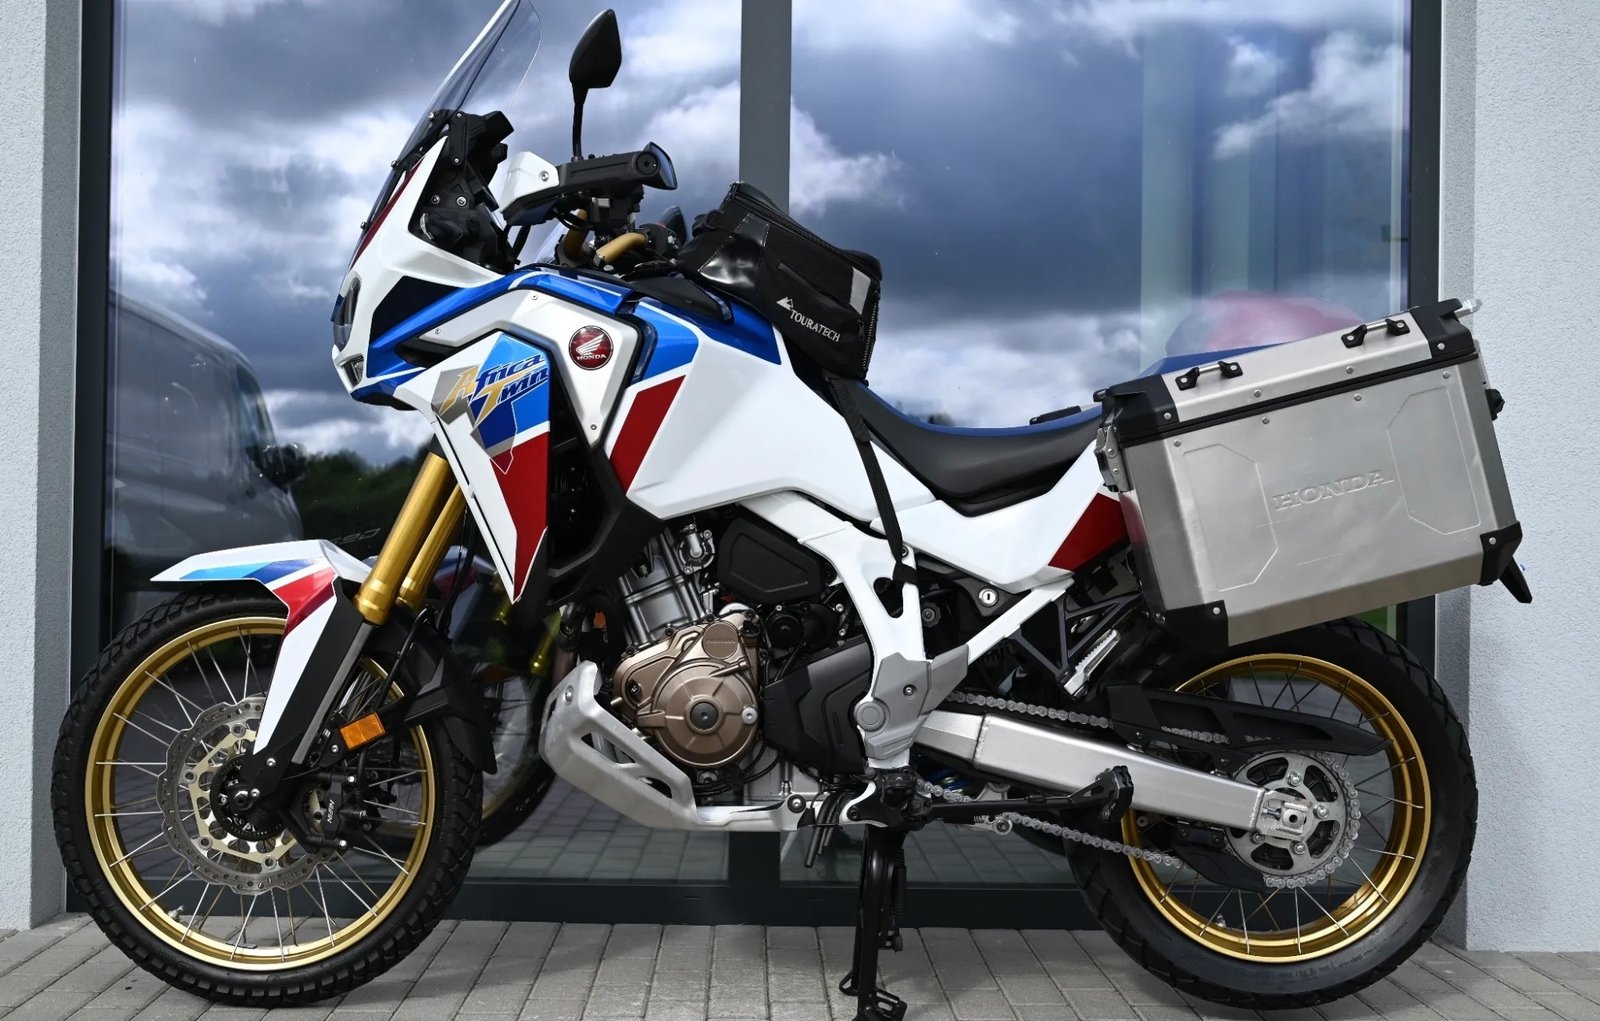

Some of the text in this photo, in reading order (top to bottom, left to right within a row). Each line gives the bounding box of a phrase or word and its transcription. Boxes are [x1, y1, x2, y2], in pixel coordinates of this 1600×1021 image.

[790, 309, 841, 342] TOURATECH
[439, 353, 546, 416] Africa
[474, 362, 548, 428] Twin
[1272, 469, 1395, 511] HONDA
